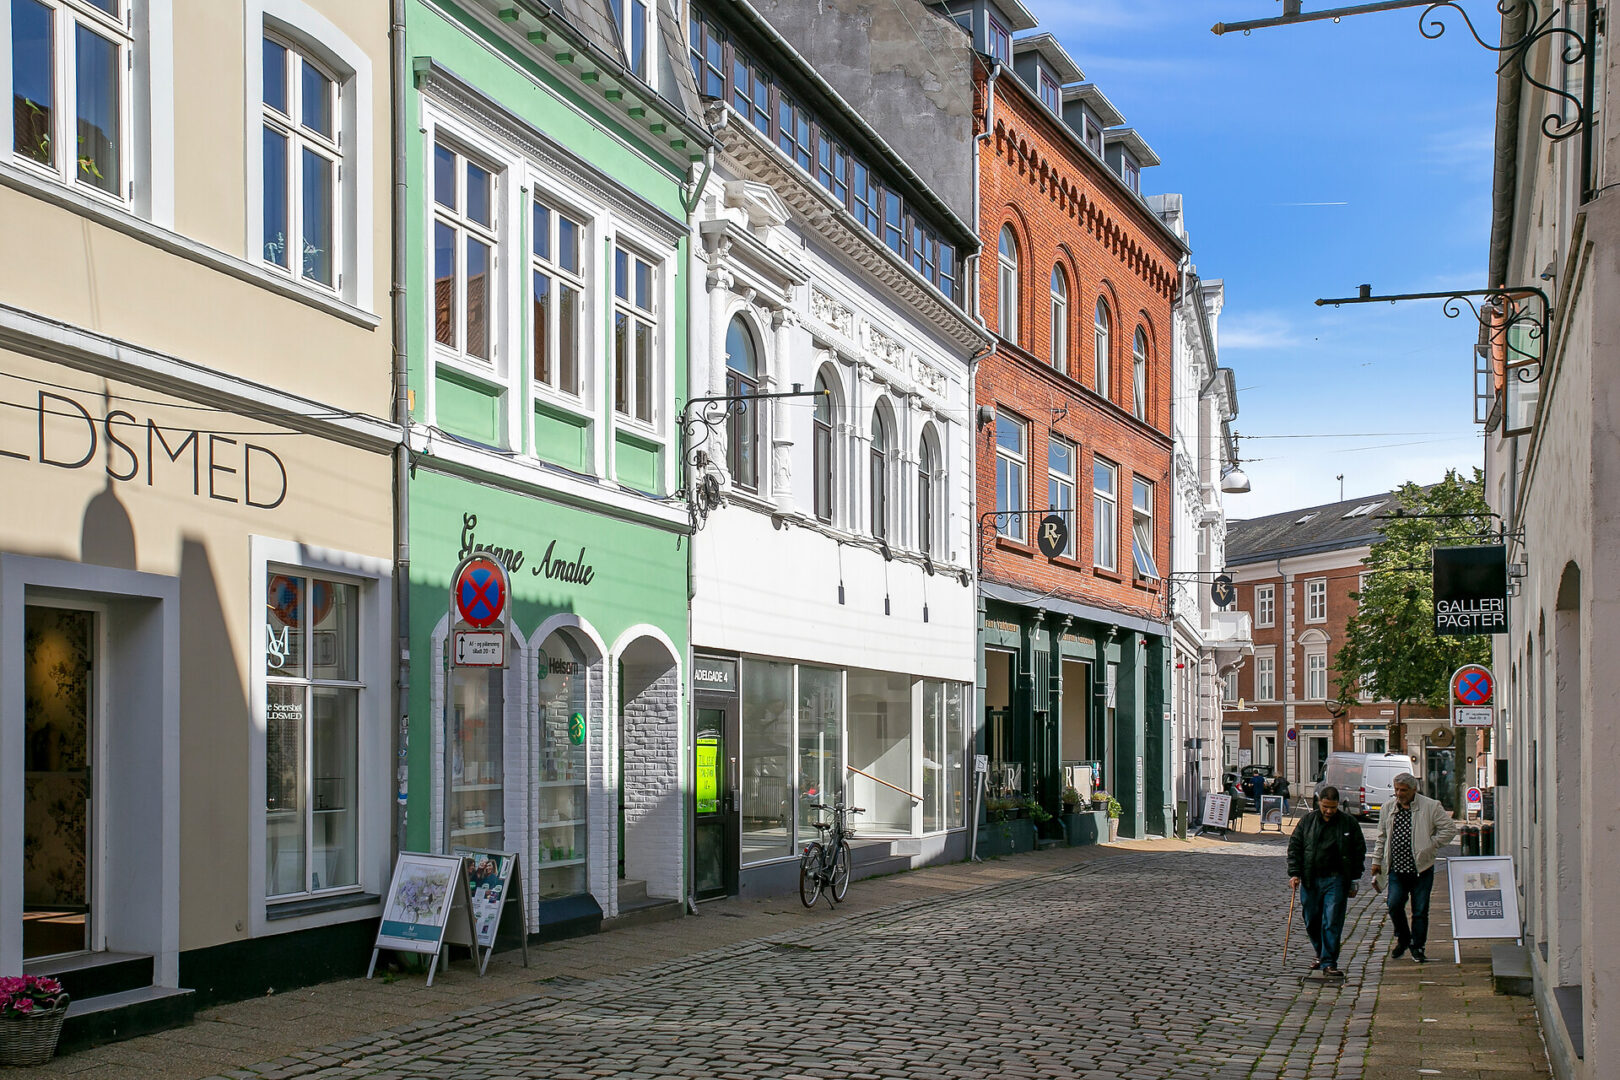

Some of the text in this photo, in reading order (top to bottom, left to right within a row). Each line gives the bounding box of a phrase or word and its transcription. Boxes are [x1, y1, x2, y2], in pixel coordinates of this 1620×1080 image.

[0, 390, 288, 509] DSMED
[532, 540, 595, 586] Amalie
[1436, 598, 1504, 613] GALLERI
[1437, 613, 1505, 628] PAGTER
[694, 669, 728, 683] ADELGADE 4
[1467, 900, 1502, 908] GALLERI
[1467, 909, 1503, 917] PAGTER
